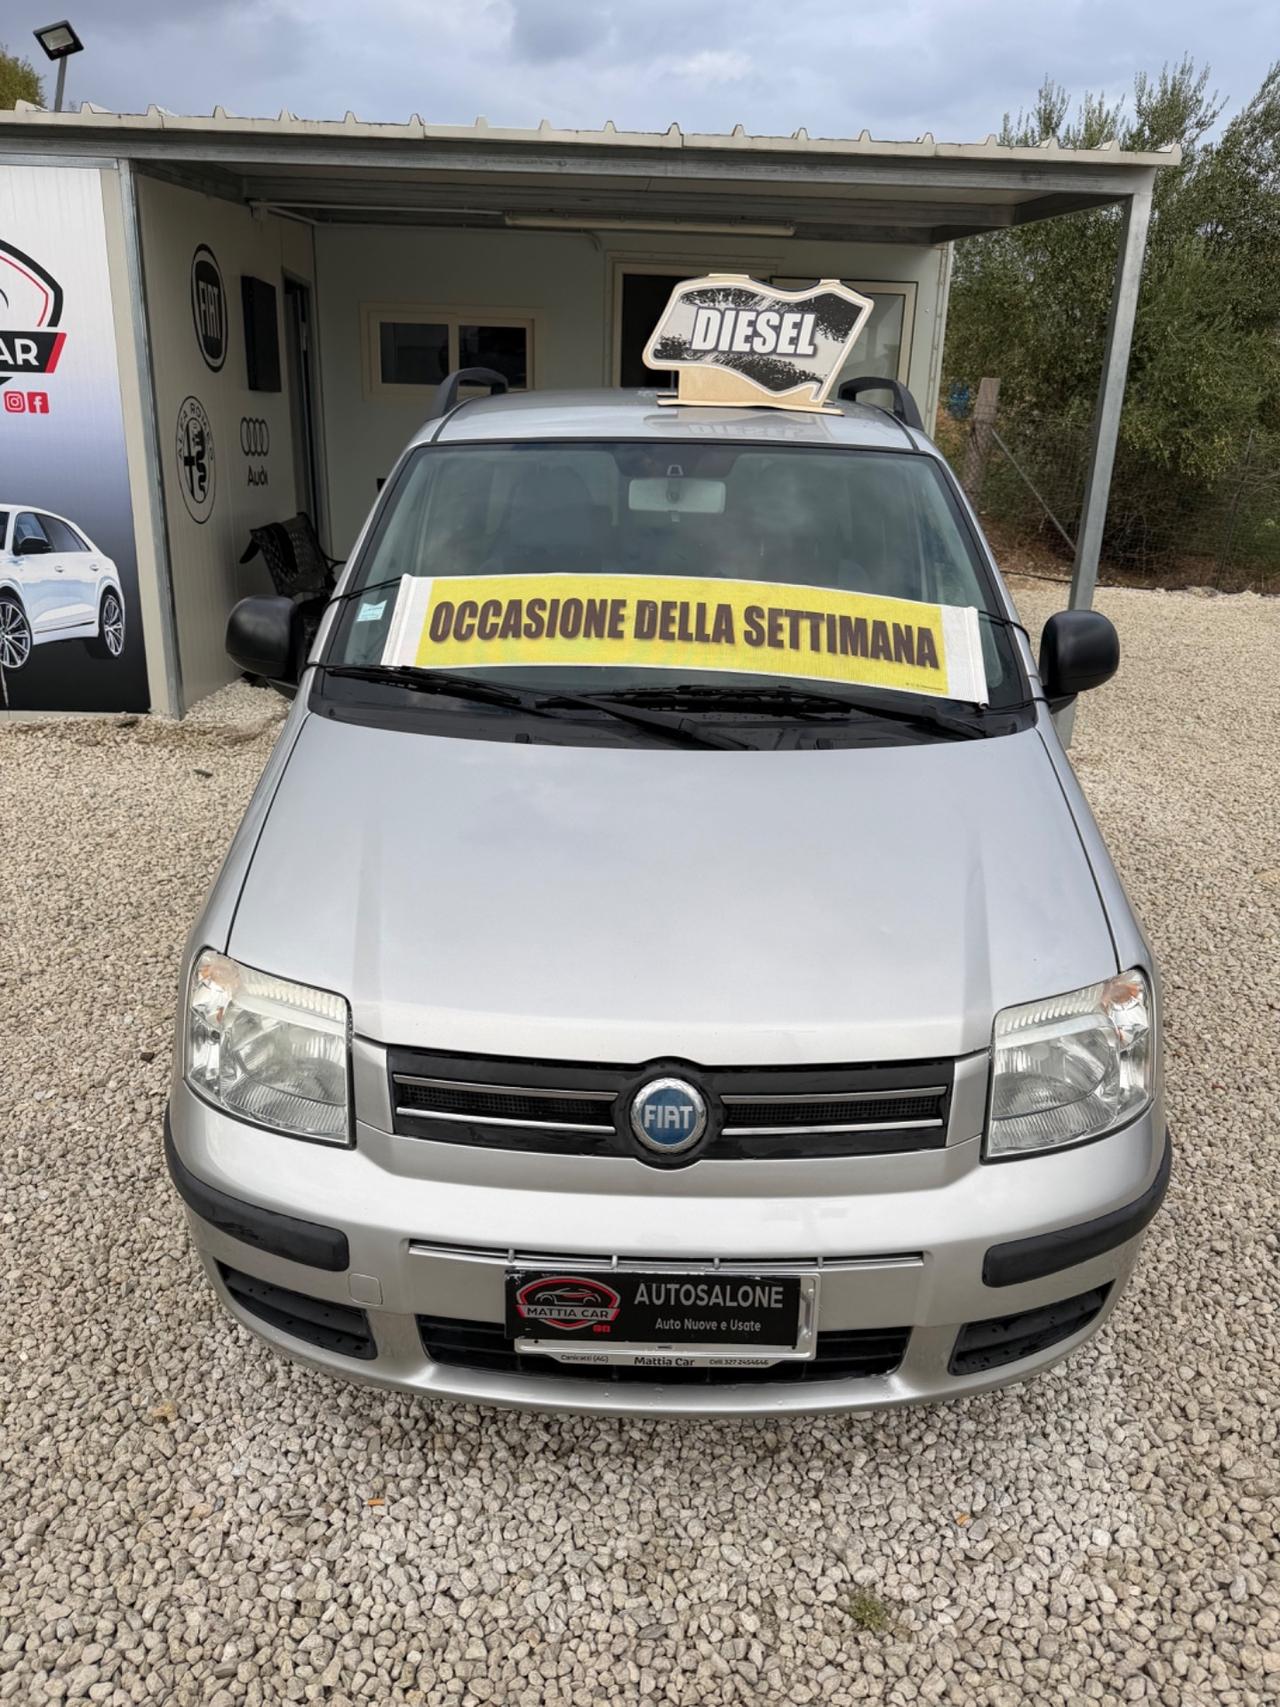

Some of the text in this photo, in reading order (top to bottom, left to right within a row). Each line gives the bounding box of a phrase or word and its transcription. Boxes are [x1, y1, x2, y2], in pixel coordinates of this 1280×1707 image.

[199, 280, 221, 339] FIAT
[691, 308, 817, 356] DIESEL
[247, 465, 269, 487] Audi
[429, 598, 940, 669] OCCASIONE DELLA SETTIMANA
[644, 1104, 694, 1129] FIAT
[634, 1283, 784, 1308] AUTOSALONE
[527, 1307, 609, 1319] MATTIA CAR
[655, 1318, 761, 1331] Auto Nuove e Usate
[634, 1356, 695, 1367] Mattia Car
